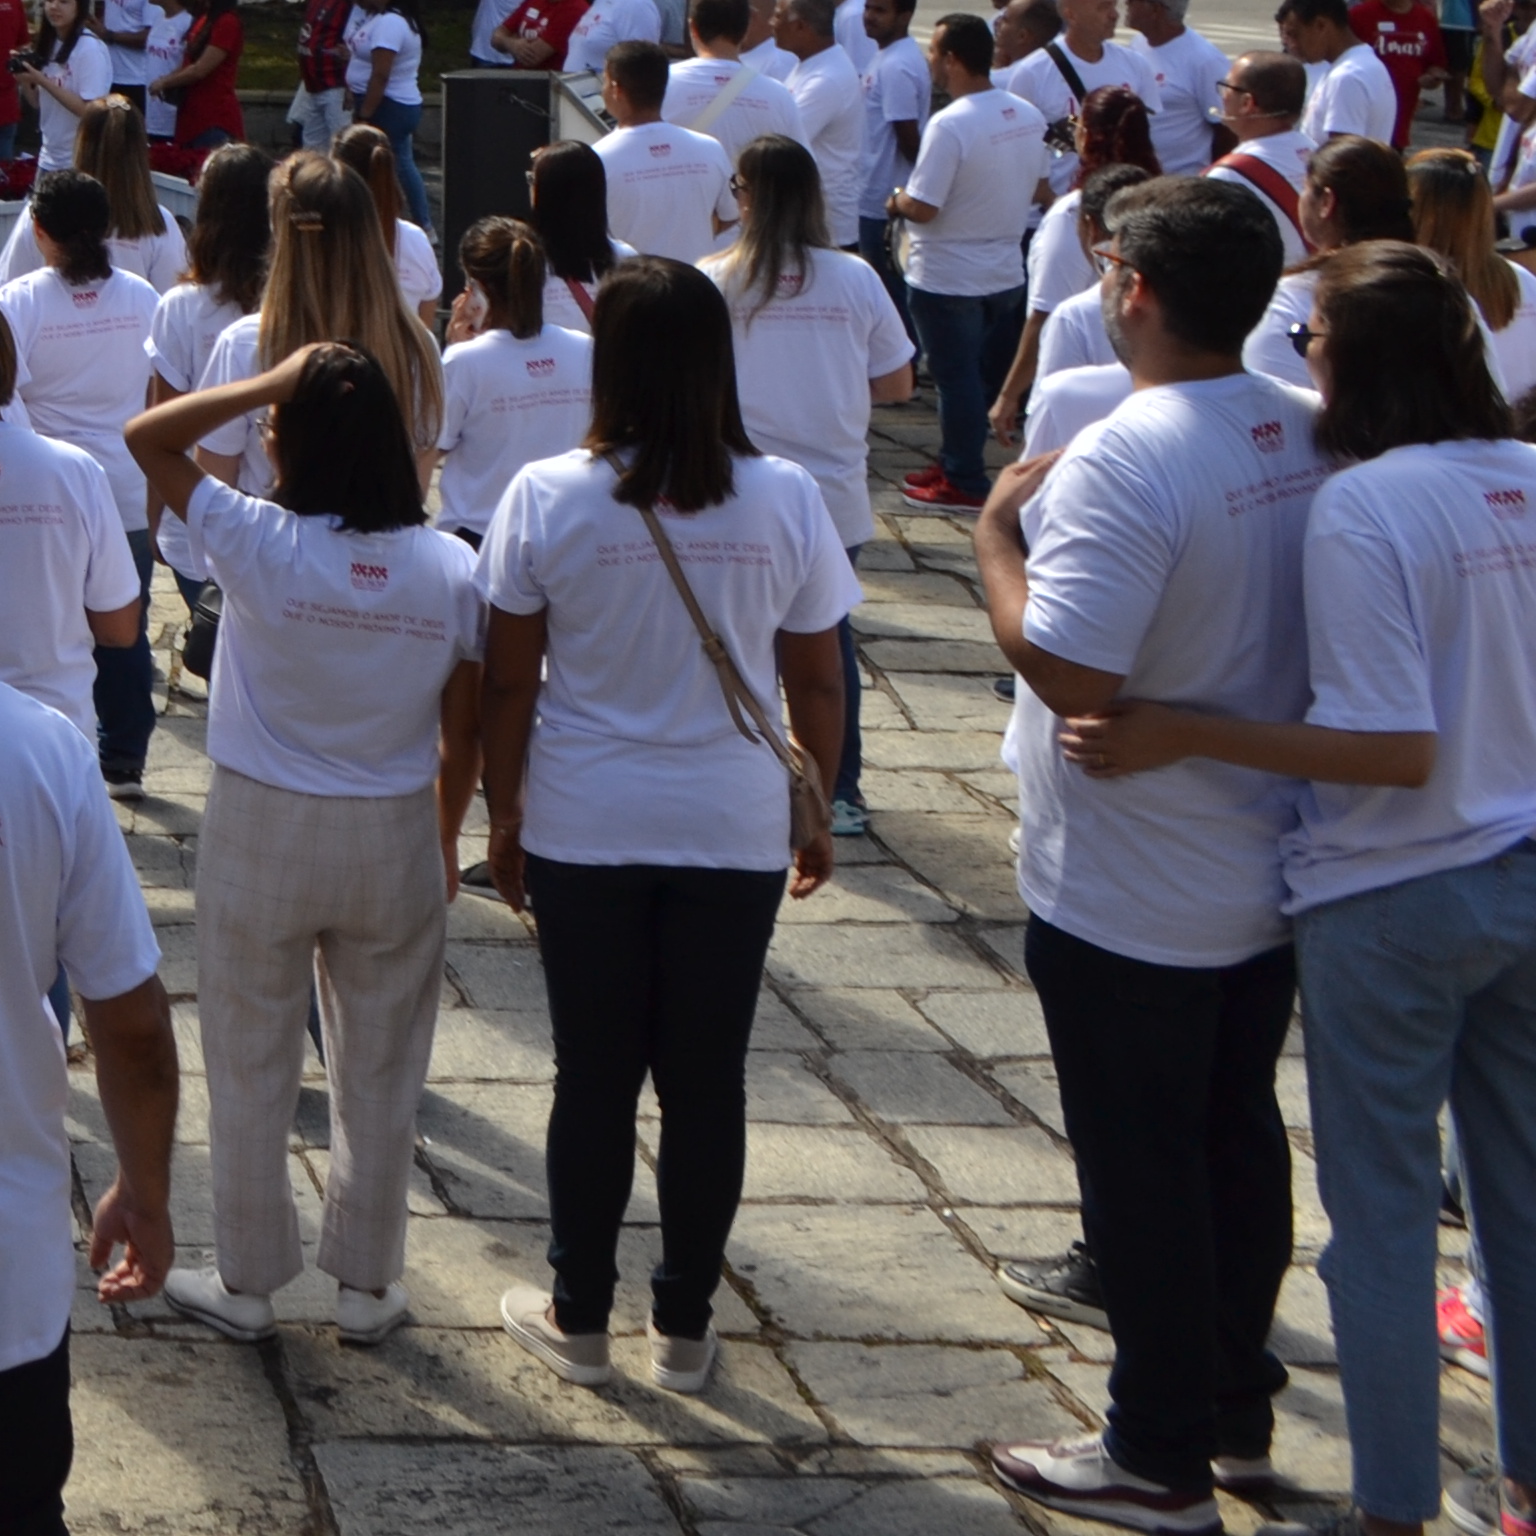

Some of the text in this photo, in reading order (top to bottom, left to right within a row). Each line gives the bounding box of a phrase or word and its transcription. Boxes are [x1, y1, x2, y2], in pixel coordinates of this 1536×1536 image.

[1373, 34, 1425, 56] Amar
[21, 505, 35, 513] DE
[38, 504, 63, 513] DEUS
[598, 545, 621, 555] QUE
[689, 542, 720, 550] AMOR
[723, 542, 739, 551] DE
[742, 543, 772, 554] DEUS
[597, 557, 620, 567] QUE
[624, 555, 633, 565] O
[282, 609, 304, 621] QUE
[307, 614, 316, 623] O
[318, 617, 355, 630] NOSSO
[358, 622, 402, 634] PRÓXIMO
[286, 597, 446, 629] QUE SEJAMOS O AMOR DE DEUS
